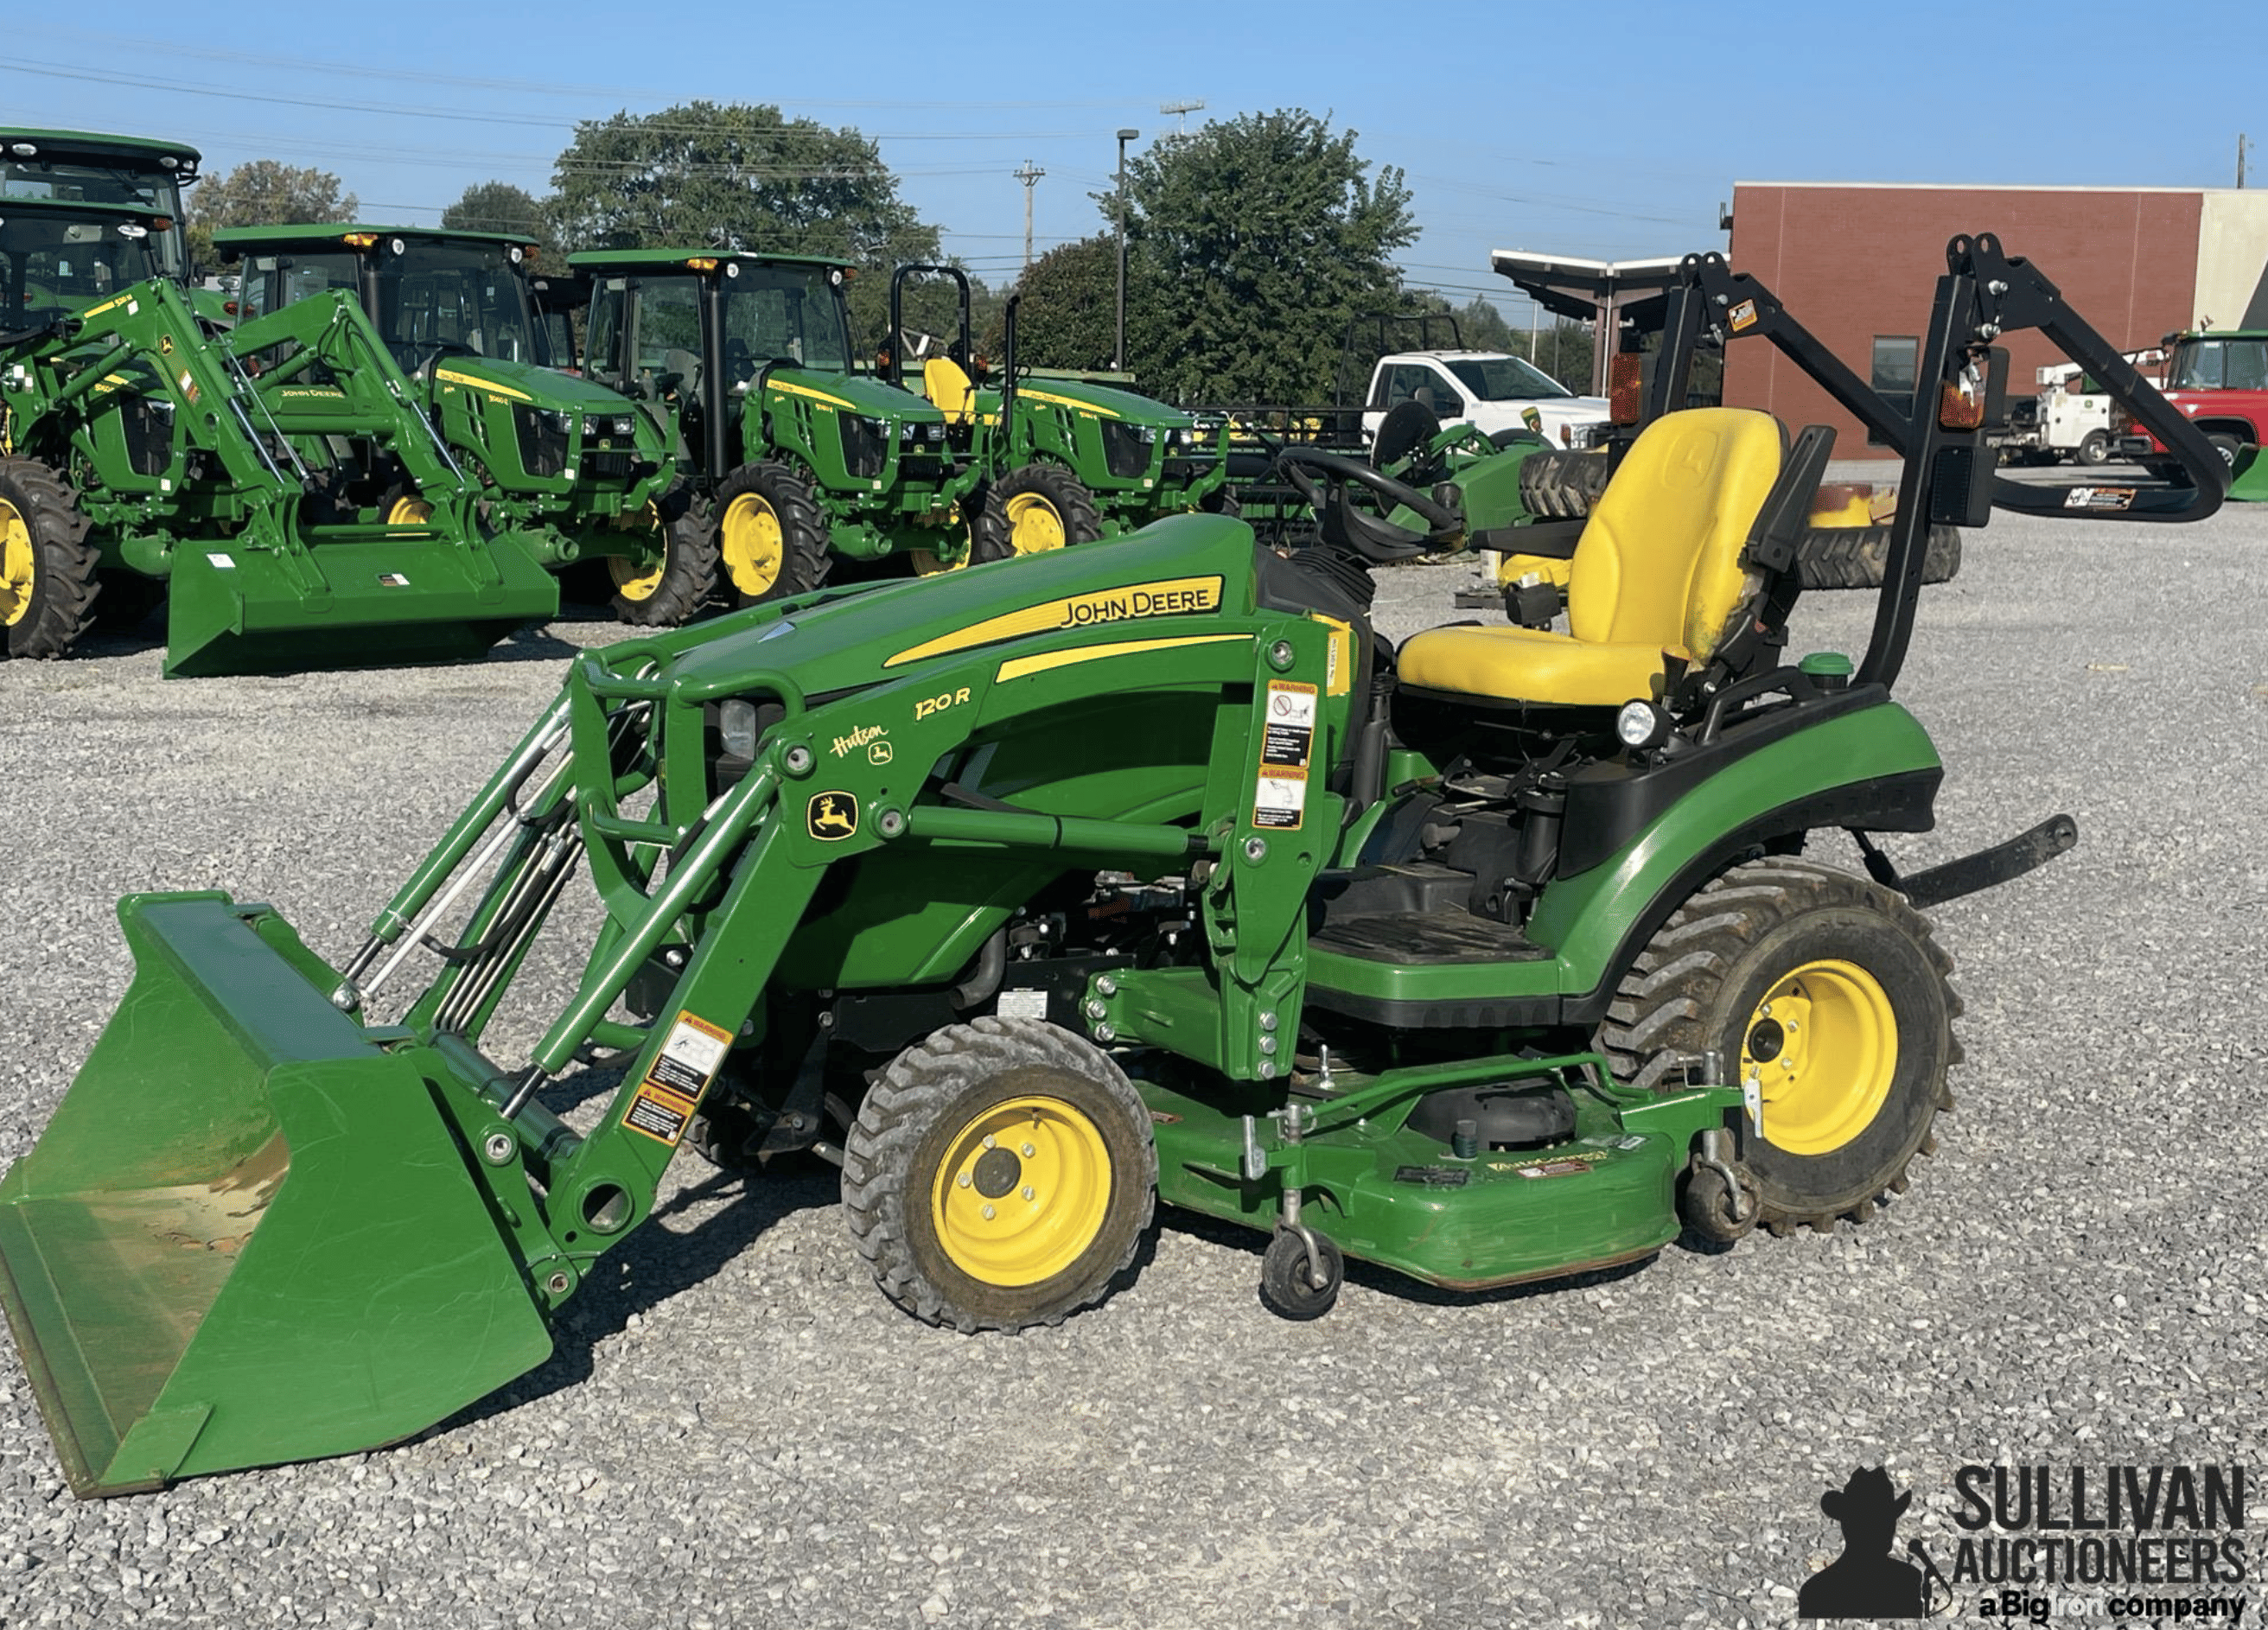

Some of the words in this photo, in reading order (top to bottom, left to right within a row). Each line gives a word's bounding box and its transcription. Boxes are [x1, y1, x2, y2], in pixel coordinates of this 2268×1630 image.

[1061, 598, 1128, 626] JOHN
[1132, 589, 1210, 614] DEERE
[1279, 683, 1316, 694] WARNING
[914, 693, 952, 721] 120
[955, 687, 971, 705] R
[829, 725, 889, 758] Hutson
[1268, 768, 1306, 780] WARNING
[692, 1019, 727, 1041] WARNING
[653, 1092, 689, 1112] WARNING
